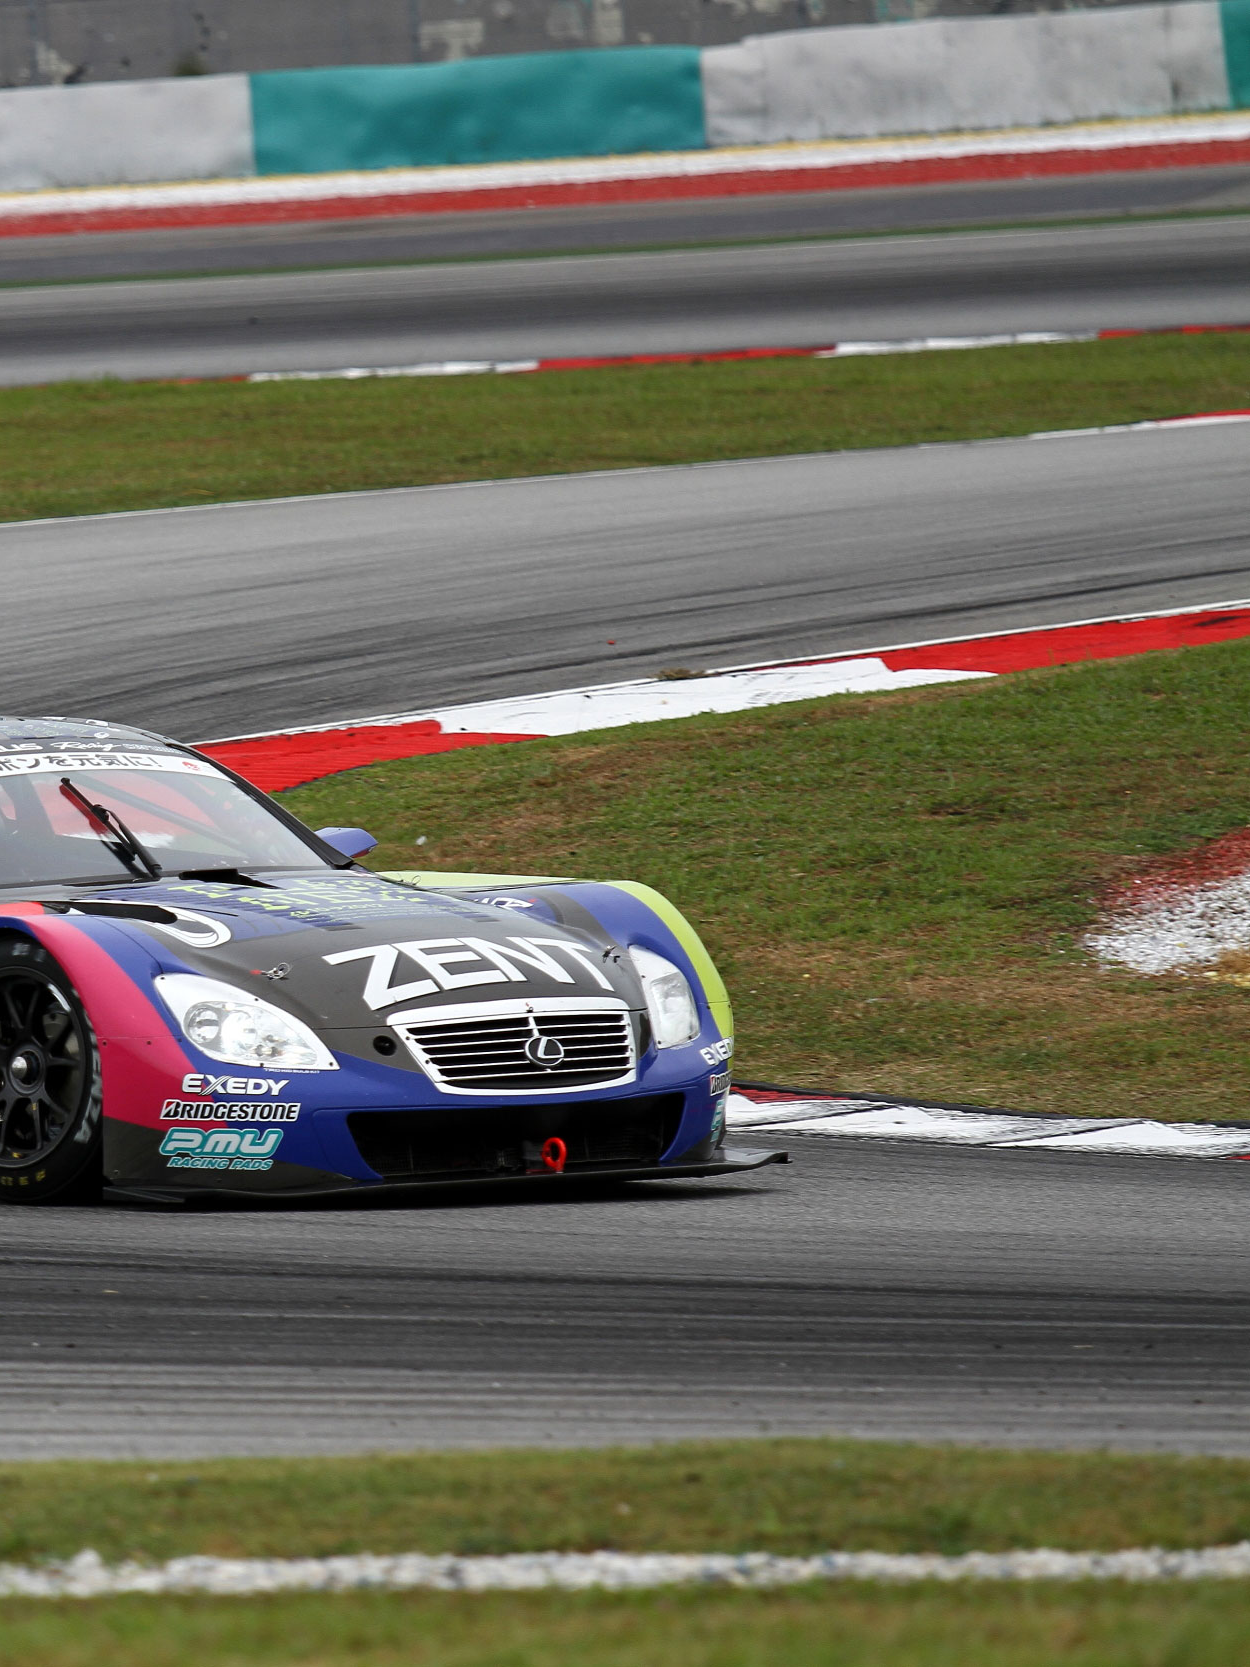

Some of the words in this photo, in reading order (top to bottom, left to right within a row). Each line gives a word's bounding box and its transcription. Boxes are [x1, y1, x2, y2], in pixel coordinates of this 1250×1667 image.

[322, 936, 615, 1011] ZENT
[182, 1073, 290, 1096] EXEDY
[161, 1099, 300, 1121] BRIDGESTONE
[167, 1157, 229, 1169] RACING
[230, 1159, 274, 1170] PADS
